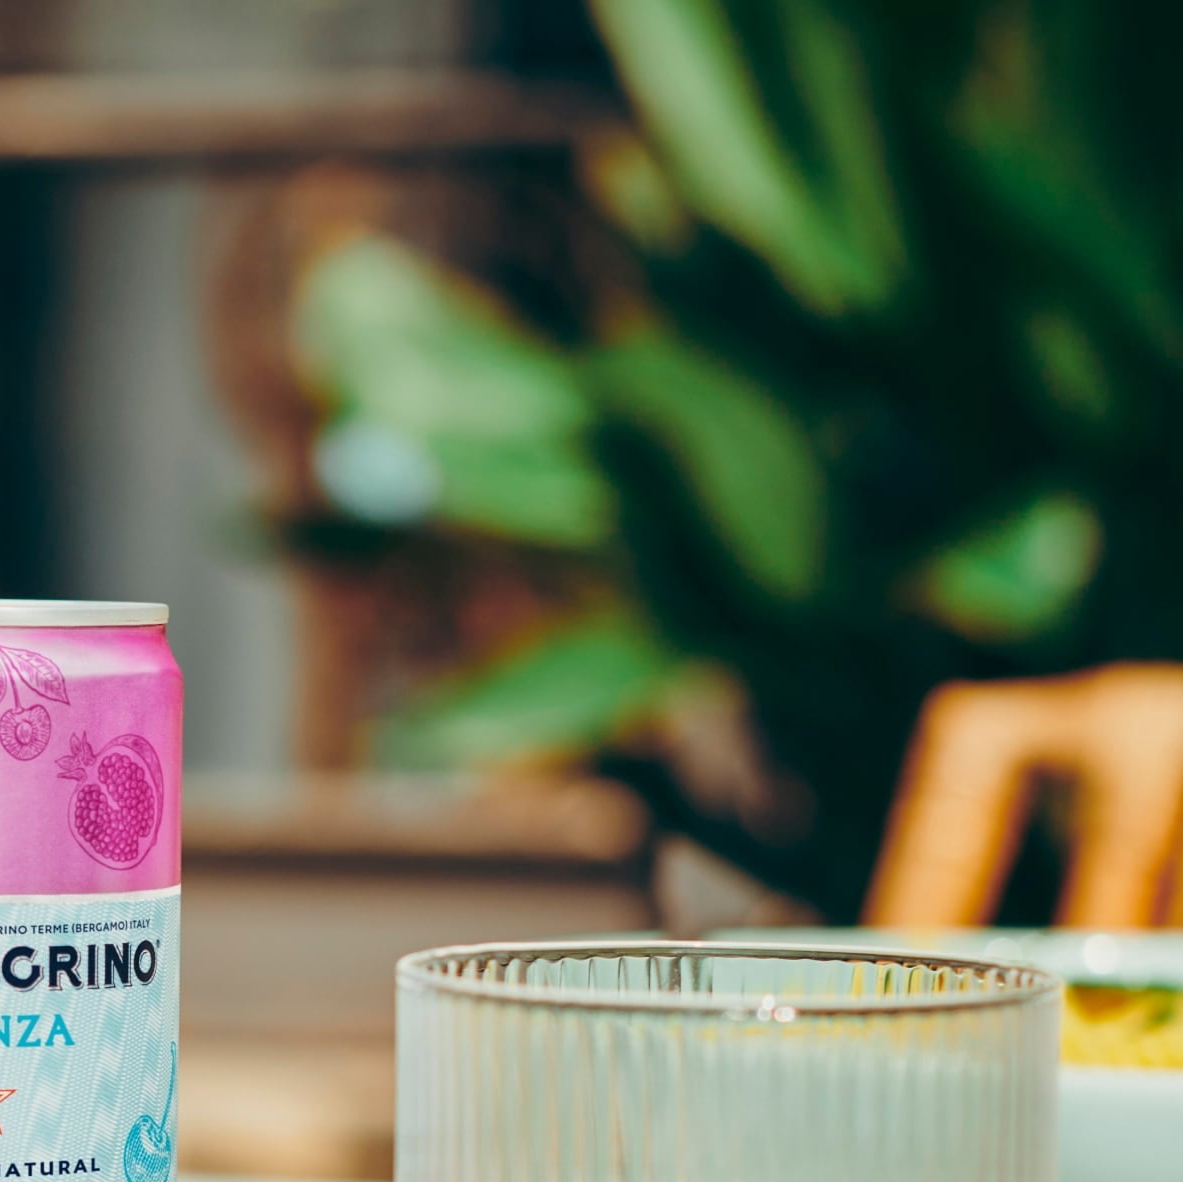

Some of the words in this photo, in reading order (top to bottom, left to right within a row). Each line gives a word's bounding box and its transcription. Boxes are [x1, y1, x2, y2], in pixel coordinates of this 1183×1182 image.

[30, 924, 69, 934] TERME
[71, 920, 128, 934] (BERGAMO)
[130, 919, 151, 930] ITALY
